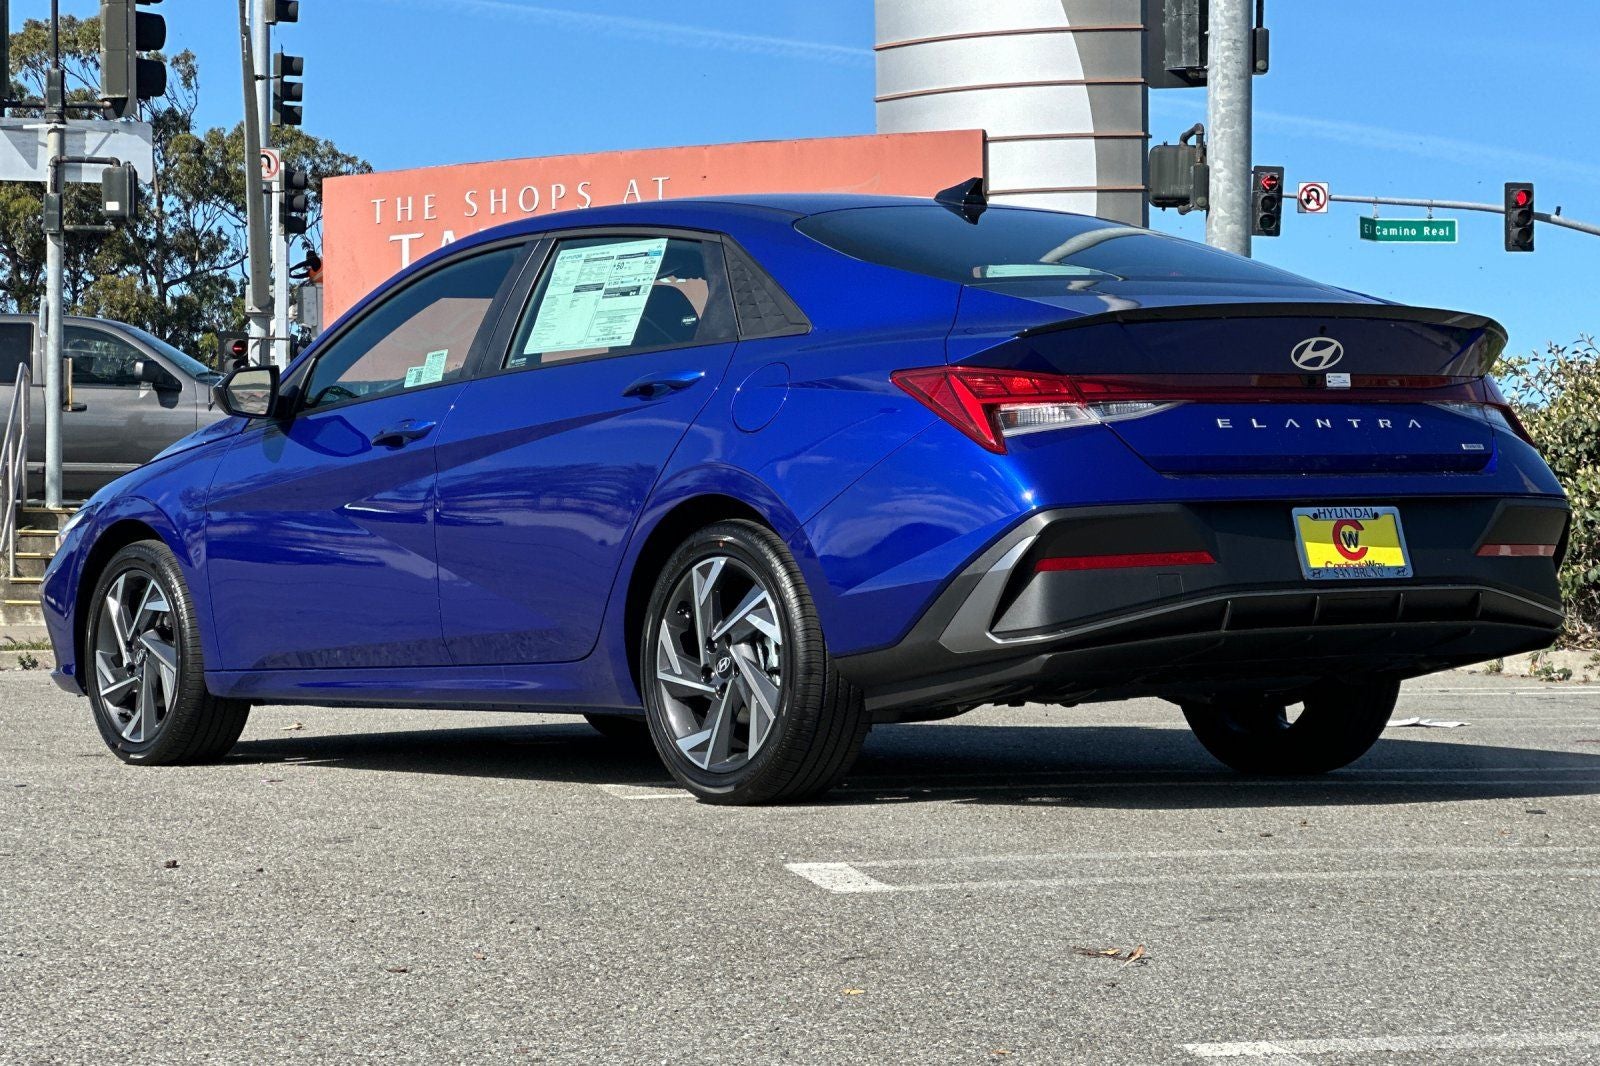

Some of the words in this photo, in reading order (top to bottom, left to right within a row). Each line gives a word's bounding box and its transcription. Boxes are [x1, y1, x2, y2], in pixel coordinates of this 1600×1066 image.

[371, 194, 437, 224] THE
[464, 181, 592, 218] SHOPS
[622, 176, 670, 204] AT
[1375, 226, 1417, 236] Camino
[1423, 226, 1449, 236] Real
[1216, 418, 1422, 429] ELANTRA
[1316, 507, 1375, 519] HYUNDAI
